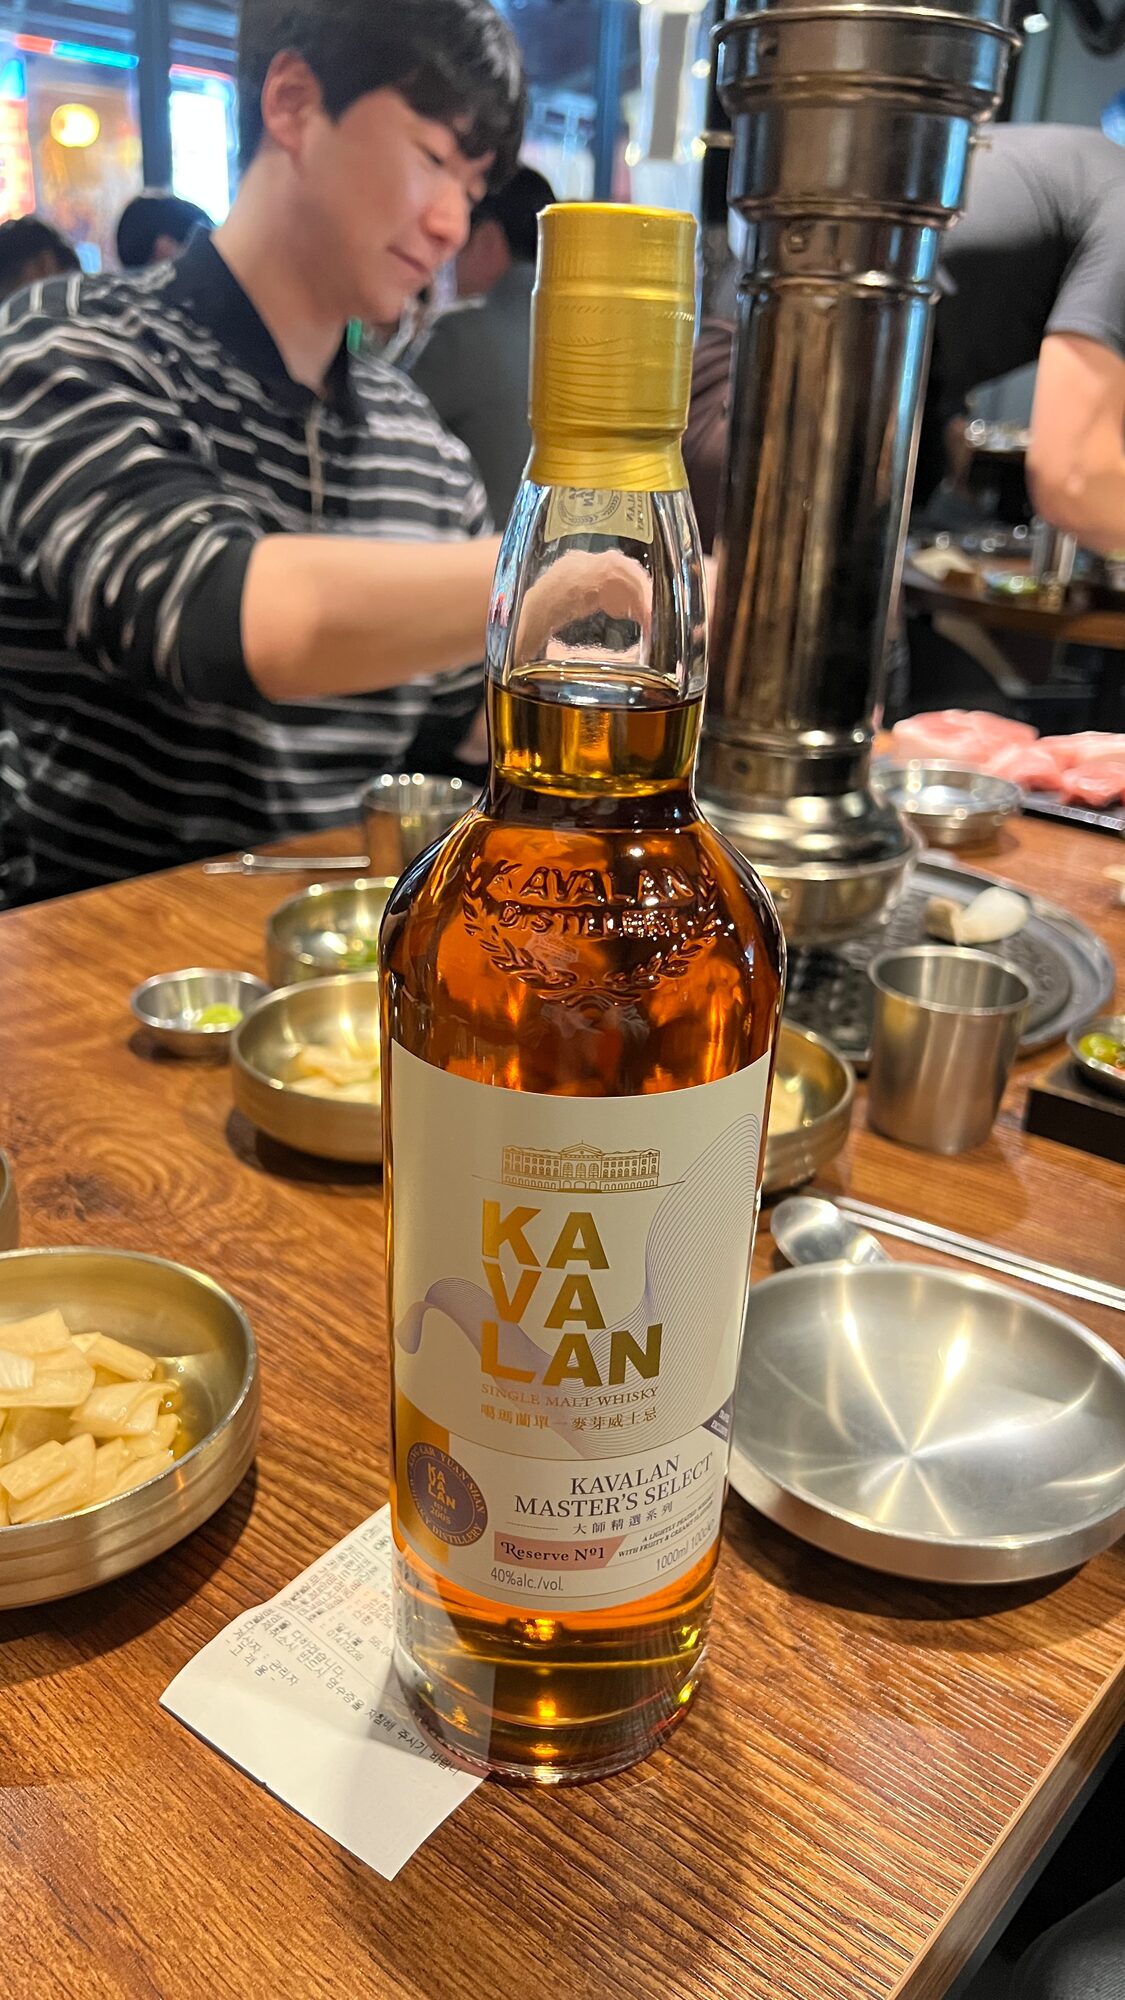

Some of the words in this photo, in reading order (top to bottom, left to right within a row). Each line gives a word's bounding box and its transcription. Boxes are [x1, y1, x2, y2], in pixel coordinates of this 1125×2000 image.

[480, 1320, 664, 1388] LAN
[481, 1383, 540, 1405] SINGLE
[545, 1395, 594, 1408] MALT
[597, 1386, 658, 1406] WHISKY
[440, 1453, 468, 1481] YUAN
[466, 1482, 486, 1515] SHAN
[569, 1455, 681, 1496] KAVALAN
[644, 1452, 713, 1506] SELECT
[572, 1501, 674, 1535] 大師精選系列
[648, 1521, 677, 1542] LIGHTLY
[431, 1522, 483, 1545] DISTILLERY
[500, 1541, 569, 1562] Reserve
[617, 1546, 639, 1558] WITH
[638, 1538, 664, 1552] FRUITY
[657, 1541, 689, 1572] 1000ml
[490, 1567, 564, 1592] 40%alc./vol.
[254, 1664, 269, 1677] 용
[269, 1659, 300, 1687] 관리자
[296, 1651, 326, 1678] 반드시
[326, 1677, 364, 1711] 영수증을
[397, 1728, 430, 1755] 주시기
[427, 1749, 462, 1776] 바랍니
